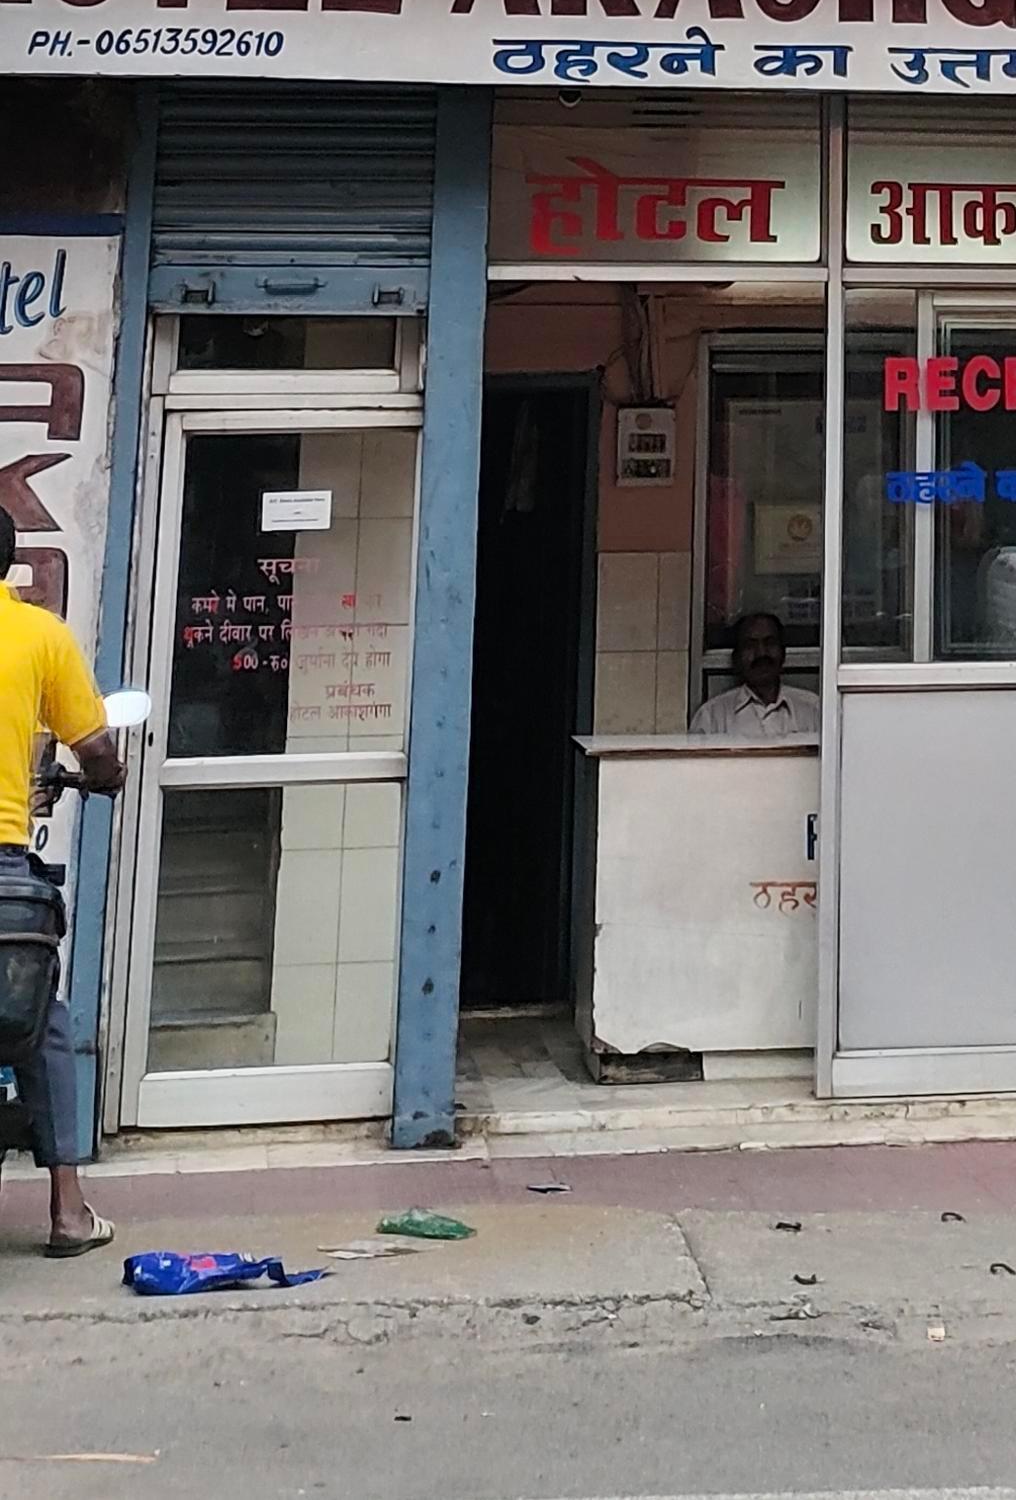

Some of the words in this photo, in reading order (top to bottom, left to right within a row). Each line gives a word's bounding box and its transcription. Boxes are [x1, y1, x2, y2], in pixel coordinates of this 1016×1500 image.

[492, 26, 725, 83] ठहरने
[752, 44, 854, 78] का
[524, 156, 787, 256] होटल
